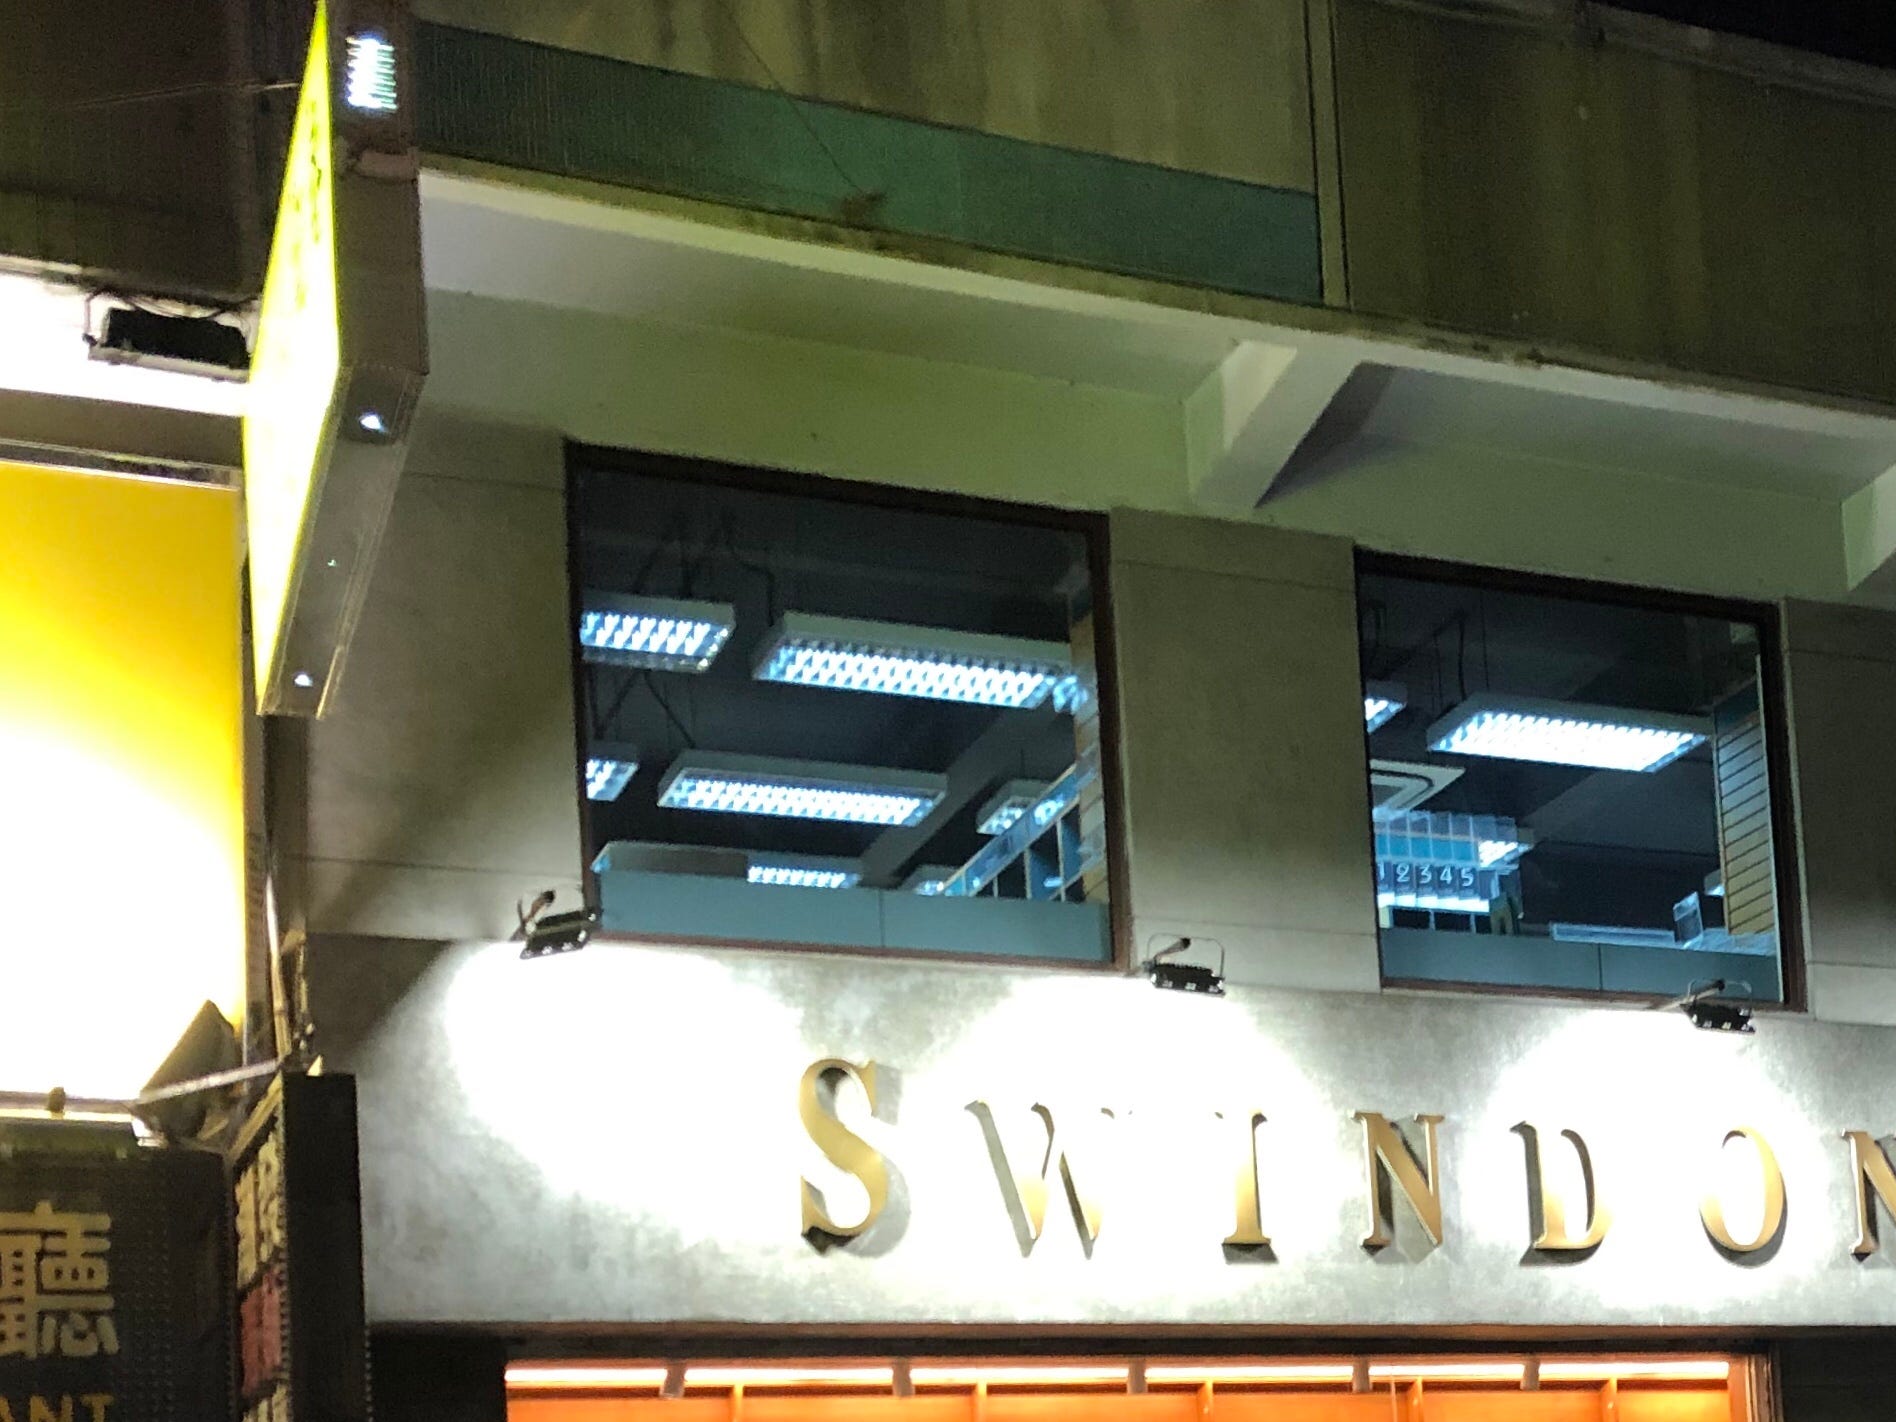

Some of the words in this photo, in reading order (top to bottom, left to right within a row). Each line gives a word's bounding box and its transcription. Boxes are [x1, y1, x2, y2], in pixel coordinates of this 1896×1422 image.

[1396, 862, 1410, 883] 2
[1419, 864, 1432, 884] 3
[1440, 865, 1453, 885] 4
[1461, 867, 1474, 887] 5
